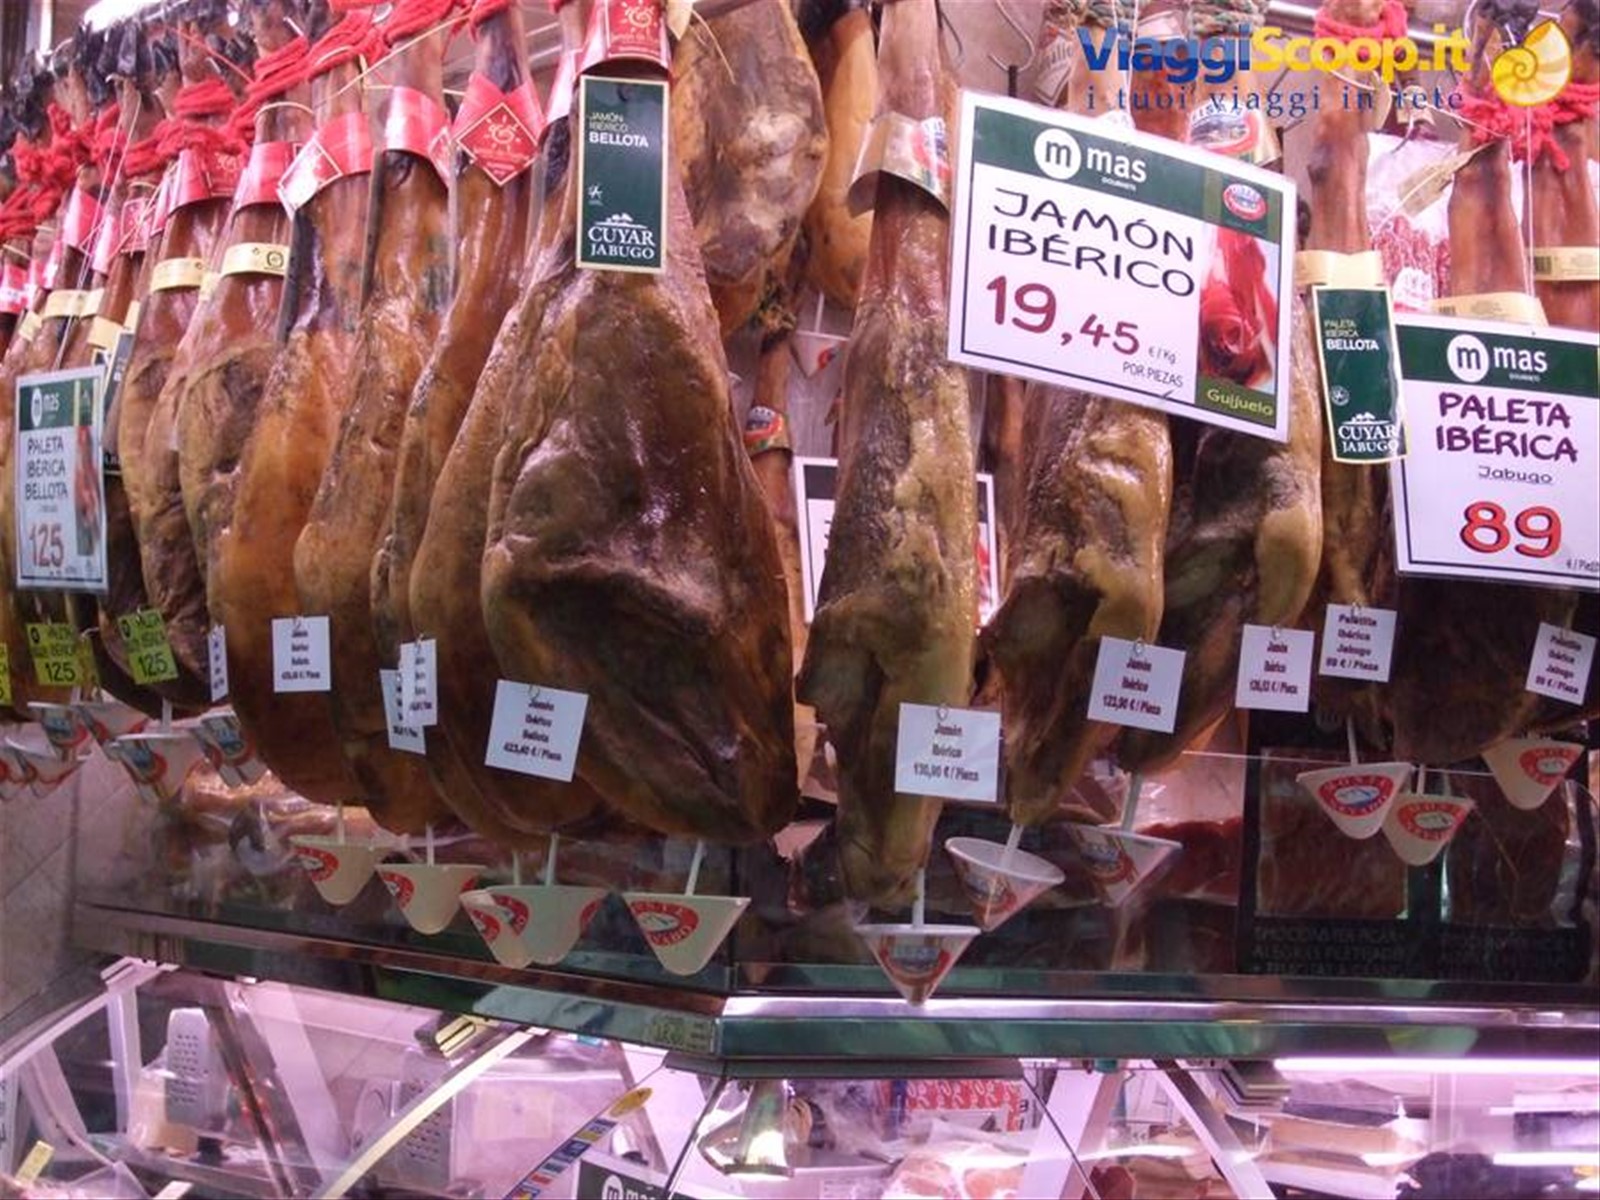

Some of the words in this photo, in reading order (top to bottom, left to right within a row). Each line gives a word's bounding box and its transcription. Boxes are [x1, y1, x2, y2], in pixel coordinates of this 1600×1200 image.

[588, 131, 650, 148] BELLOTA
[1045, 141, 1072, 168] m
[1086, 147, 1148, 183] mas
[587, 226, 656, 247] CUYAR
[993, 187, 1194, 262] JAMÓN
[589, 243, 656, 260] JABUGO
[988, 224, 1195, 297] IBÉRICO
[986, 275, 1141, 356] 19,45
[1326, 338, 1380, 351] BELLOTA
[1455, 346, 1482, 371] m
[1493, 346, 1549, 373] mas
[1438, 391, 1572, 429] PALETA
[27, 435, 65, 455] PALETA
[1338, 424, 1399, 442] CUYAR
[1436, 424, 1579, 463] IBÉRICA
[1342, 439, 1400, 454] JABUGO
[1478, 465, 1553, 484] Jabugo
[25, 483, 68, 501] BELLOTA
[1459, 500, 1562, 558] 89
[28, 523, 65, 568] 125
[44, 661, 76, 683] 125
[137, 652, 169, 678] 125
